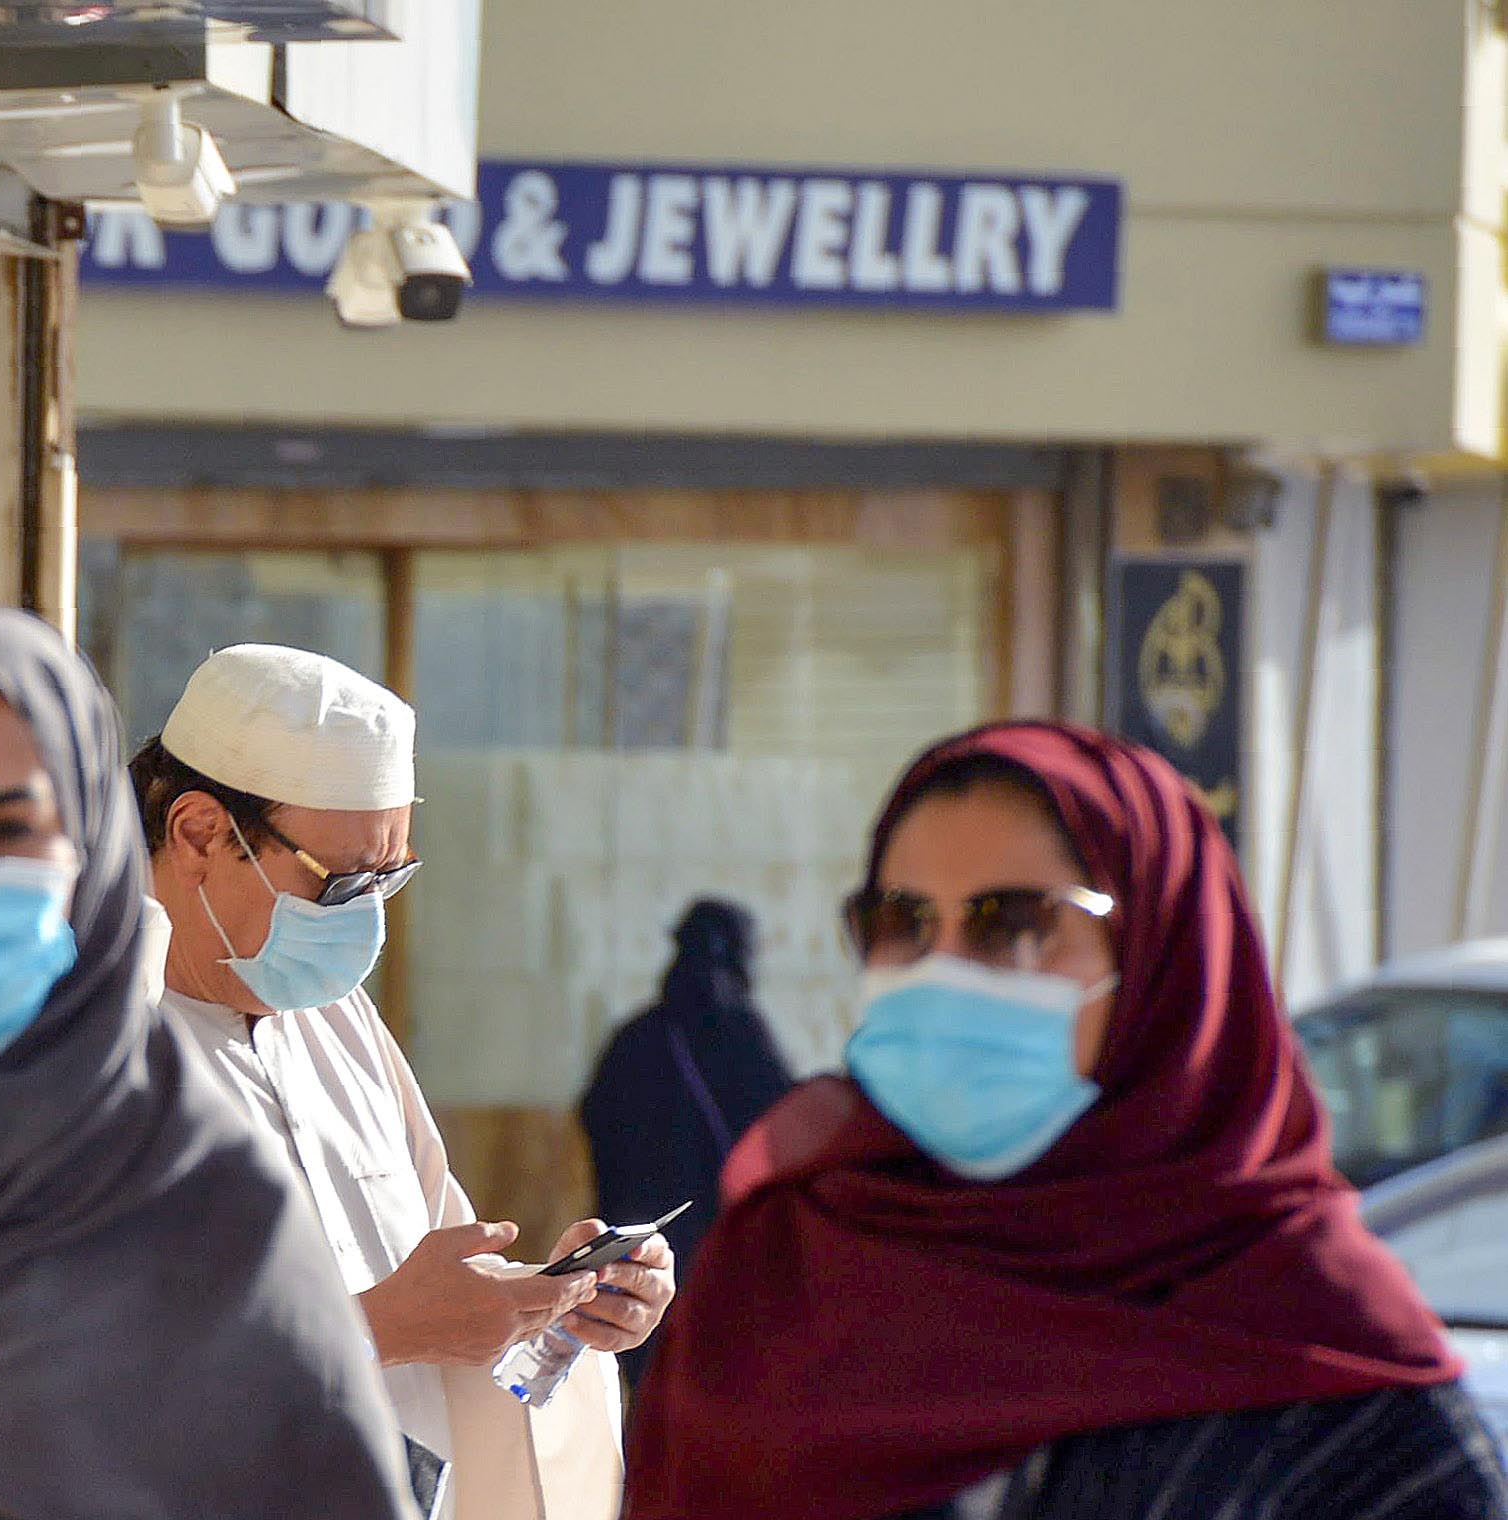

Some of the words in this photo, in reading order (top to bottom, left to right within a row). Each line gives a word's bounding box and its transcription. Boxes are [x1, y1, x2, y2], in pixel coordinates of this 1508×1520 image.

[212, 201, 482, 275] GO
[491, 170, 569, 282] &
[585, 172, 1089, 297] JEWELLRY
